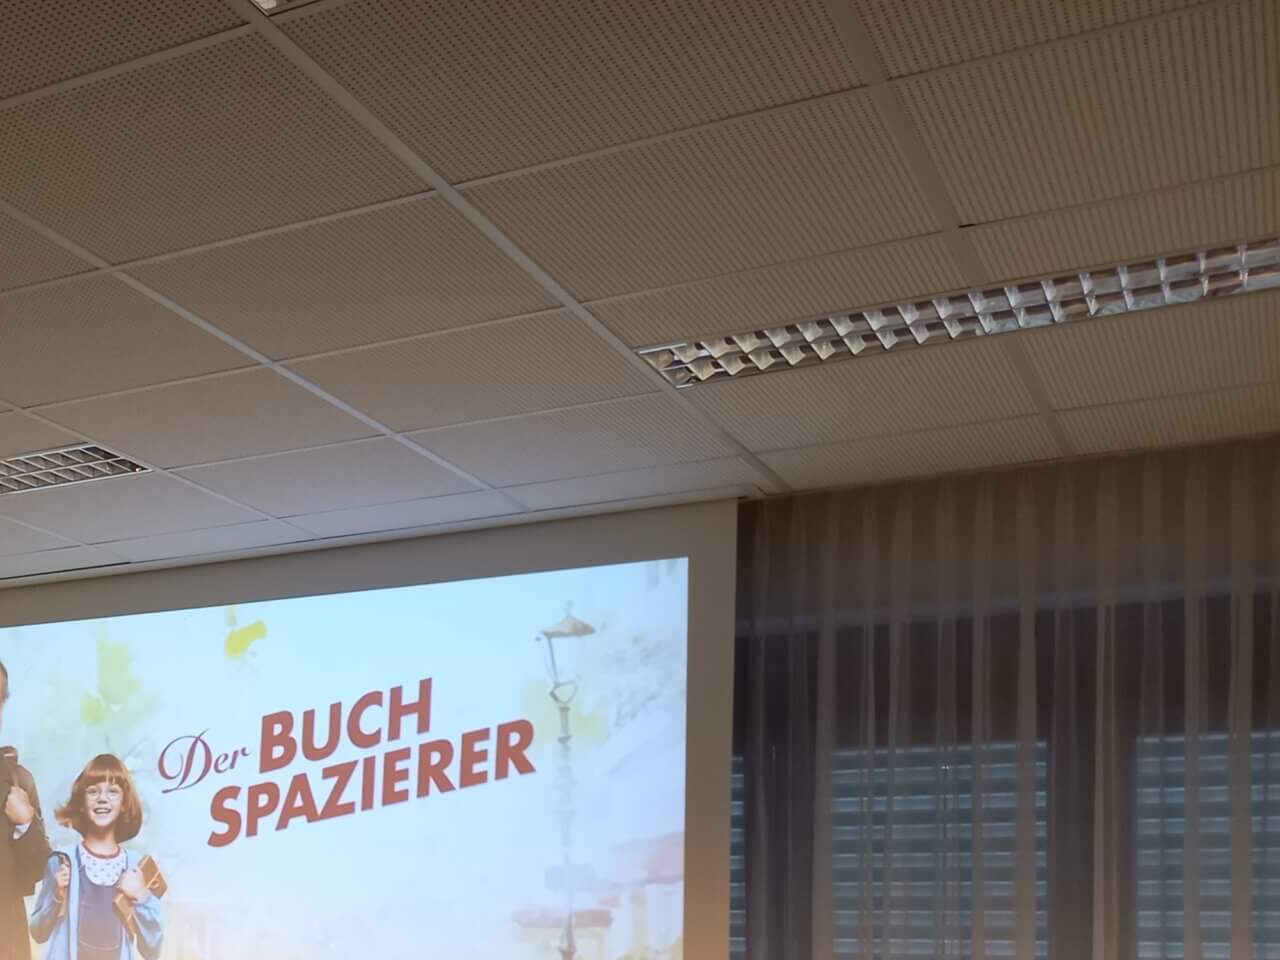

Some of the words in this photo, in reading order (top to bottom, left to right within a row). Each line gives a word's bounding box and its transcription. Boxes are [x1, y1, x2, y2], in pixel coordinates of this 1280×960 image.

[158, 728, 250, 794] Der
[258, 677, 433, 775] BUCH
[207, 718, 537, 849] SPAZIERER
